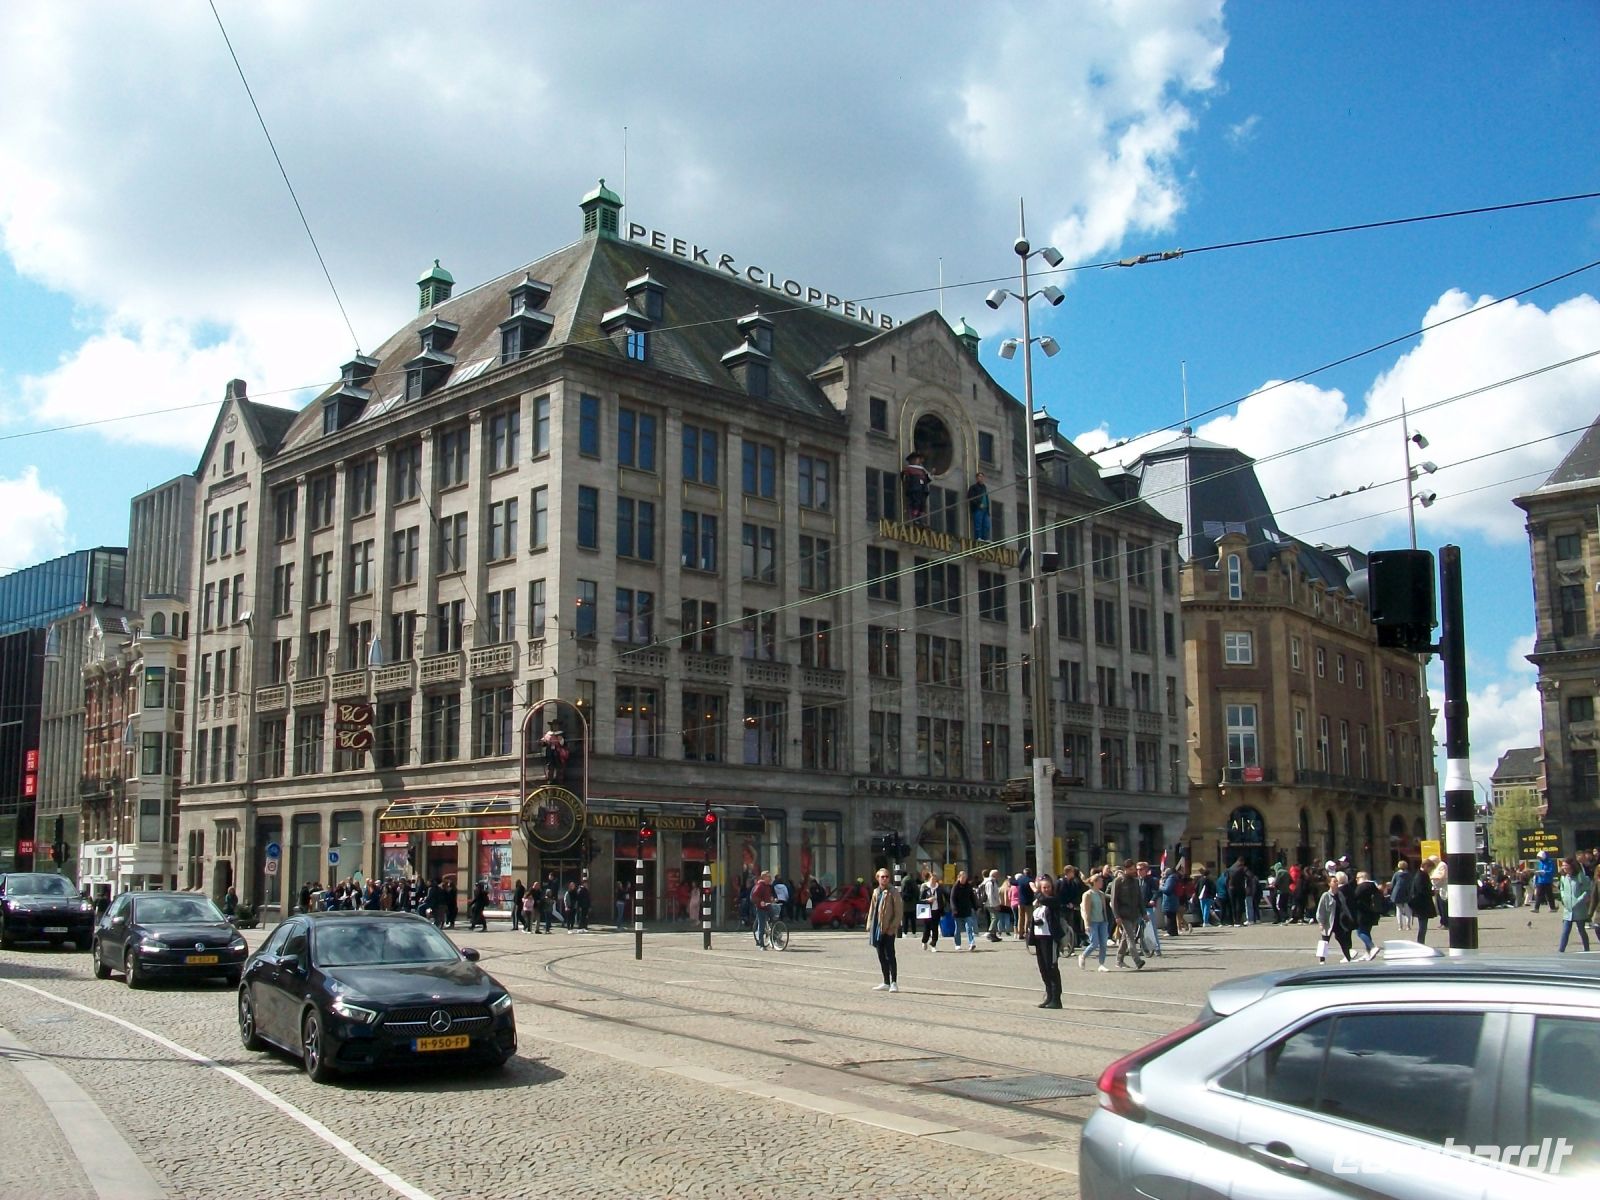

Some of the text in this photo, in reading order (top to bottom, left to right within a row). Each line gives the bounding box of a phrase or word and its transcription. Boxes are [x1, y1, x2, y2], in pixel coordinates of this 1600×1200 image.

[627, 221, 904, 331] PEEK & CLOPPENB
[879, 517, 955, 552] MADAME
[384, 816, 457, 831] MADAME TUSSAUD
[593, 814, 639, 827] MADAM
[420, 1037, 467, 1049] H-950-FP
